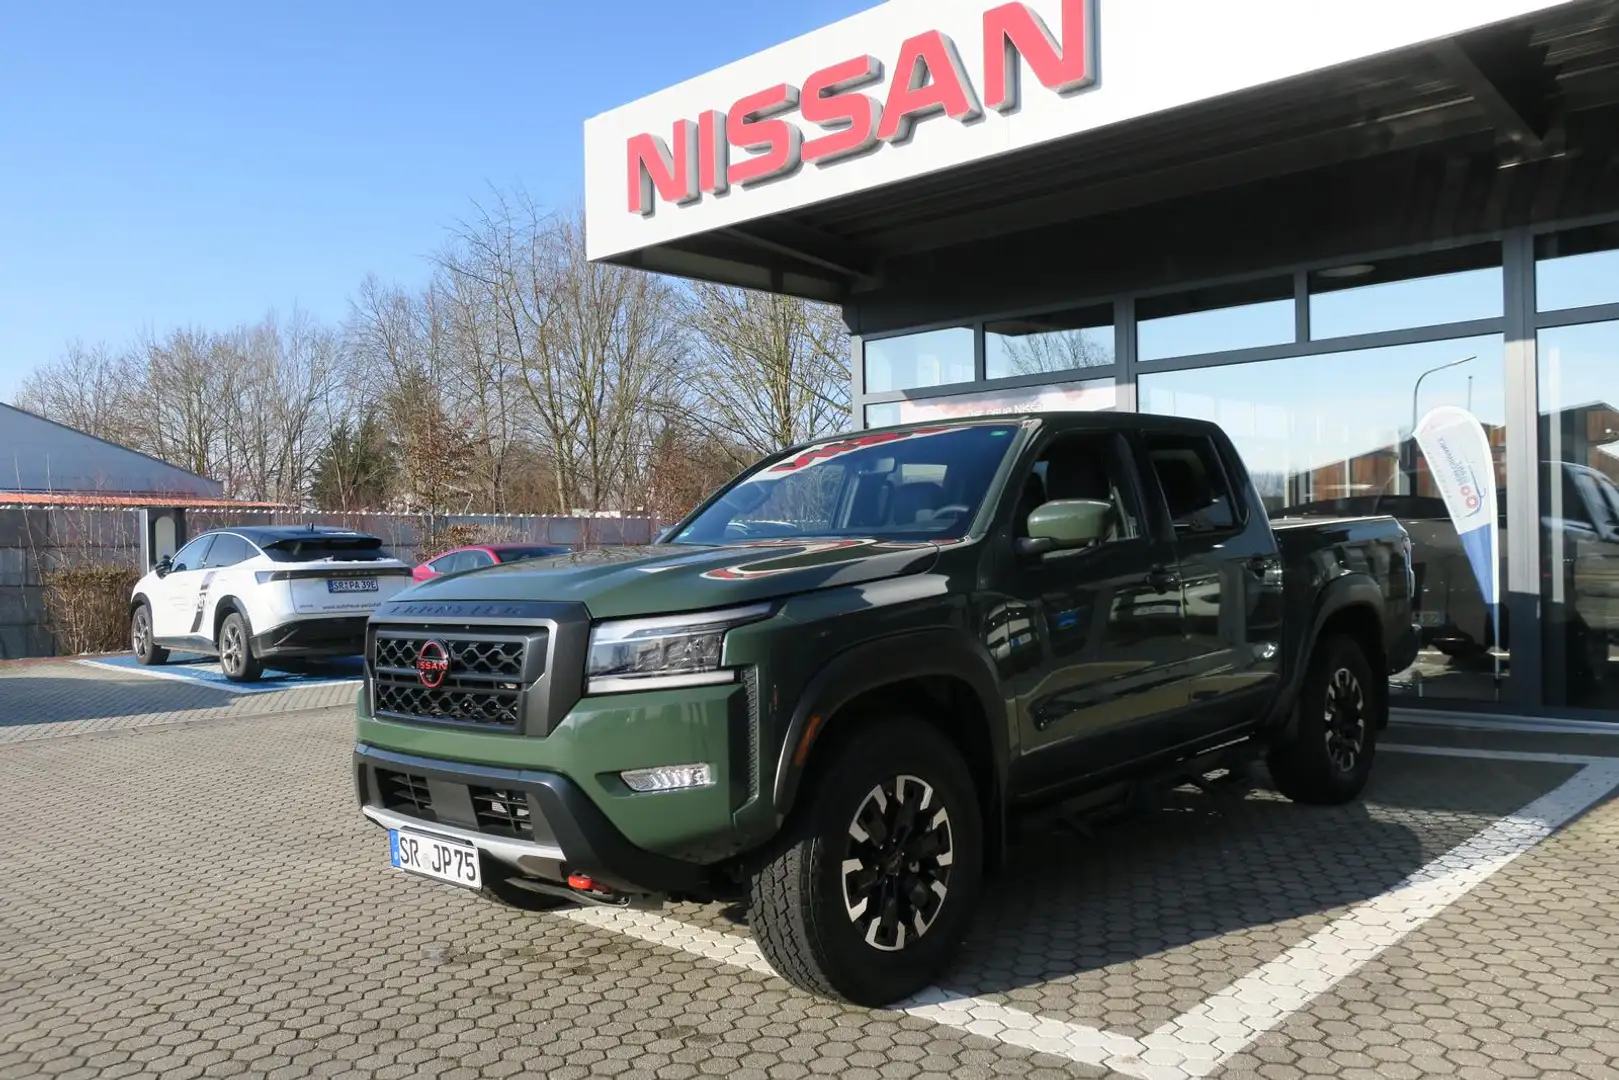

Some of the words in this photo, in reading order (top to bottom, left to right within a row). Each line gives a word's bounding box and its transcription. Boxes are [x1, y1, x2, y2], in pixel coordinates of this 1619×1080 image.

[627, 0, 1100, 216] NISSAN
[333, 581, 345, 590] SR
[349, 580, 361, 589] PA
[361, 580, 377, 589] 39E
[399, 836, 421, 868] SR
